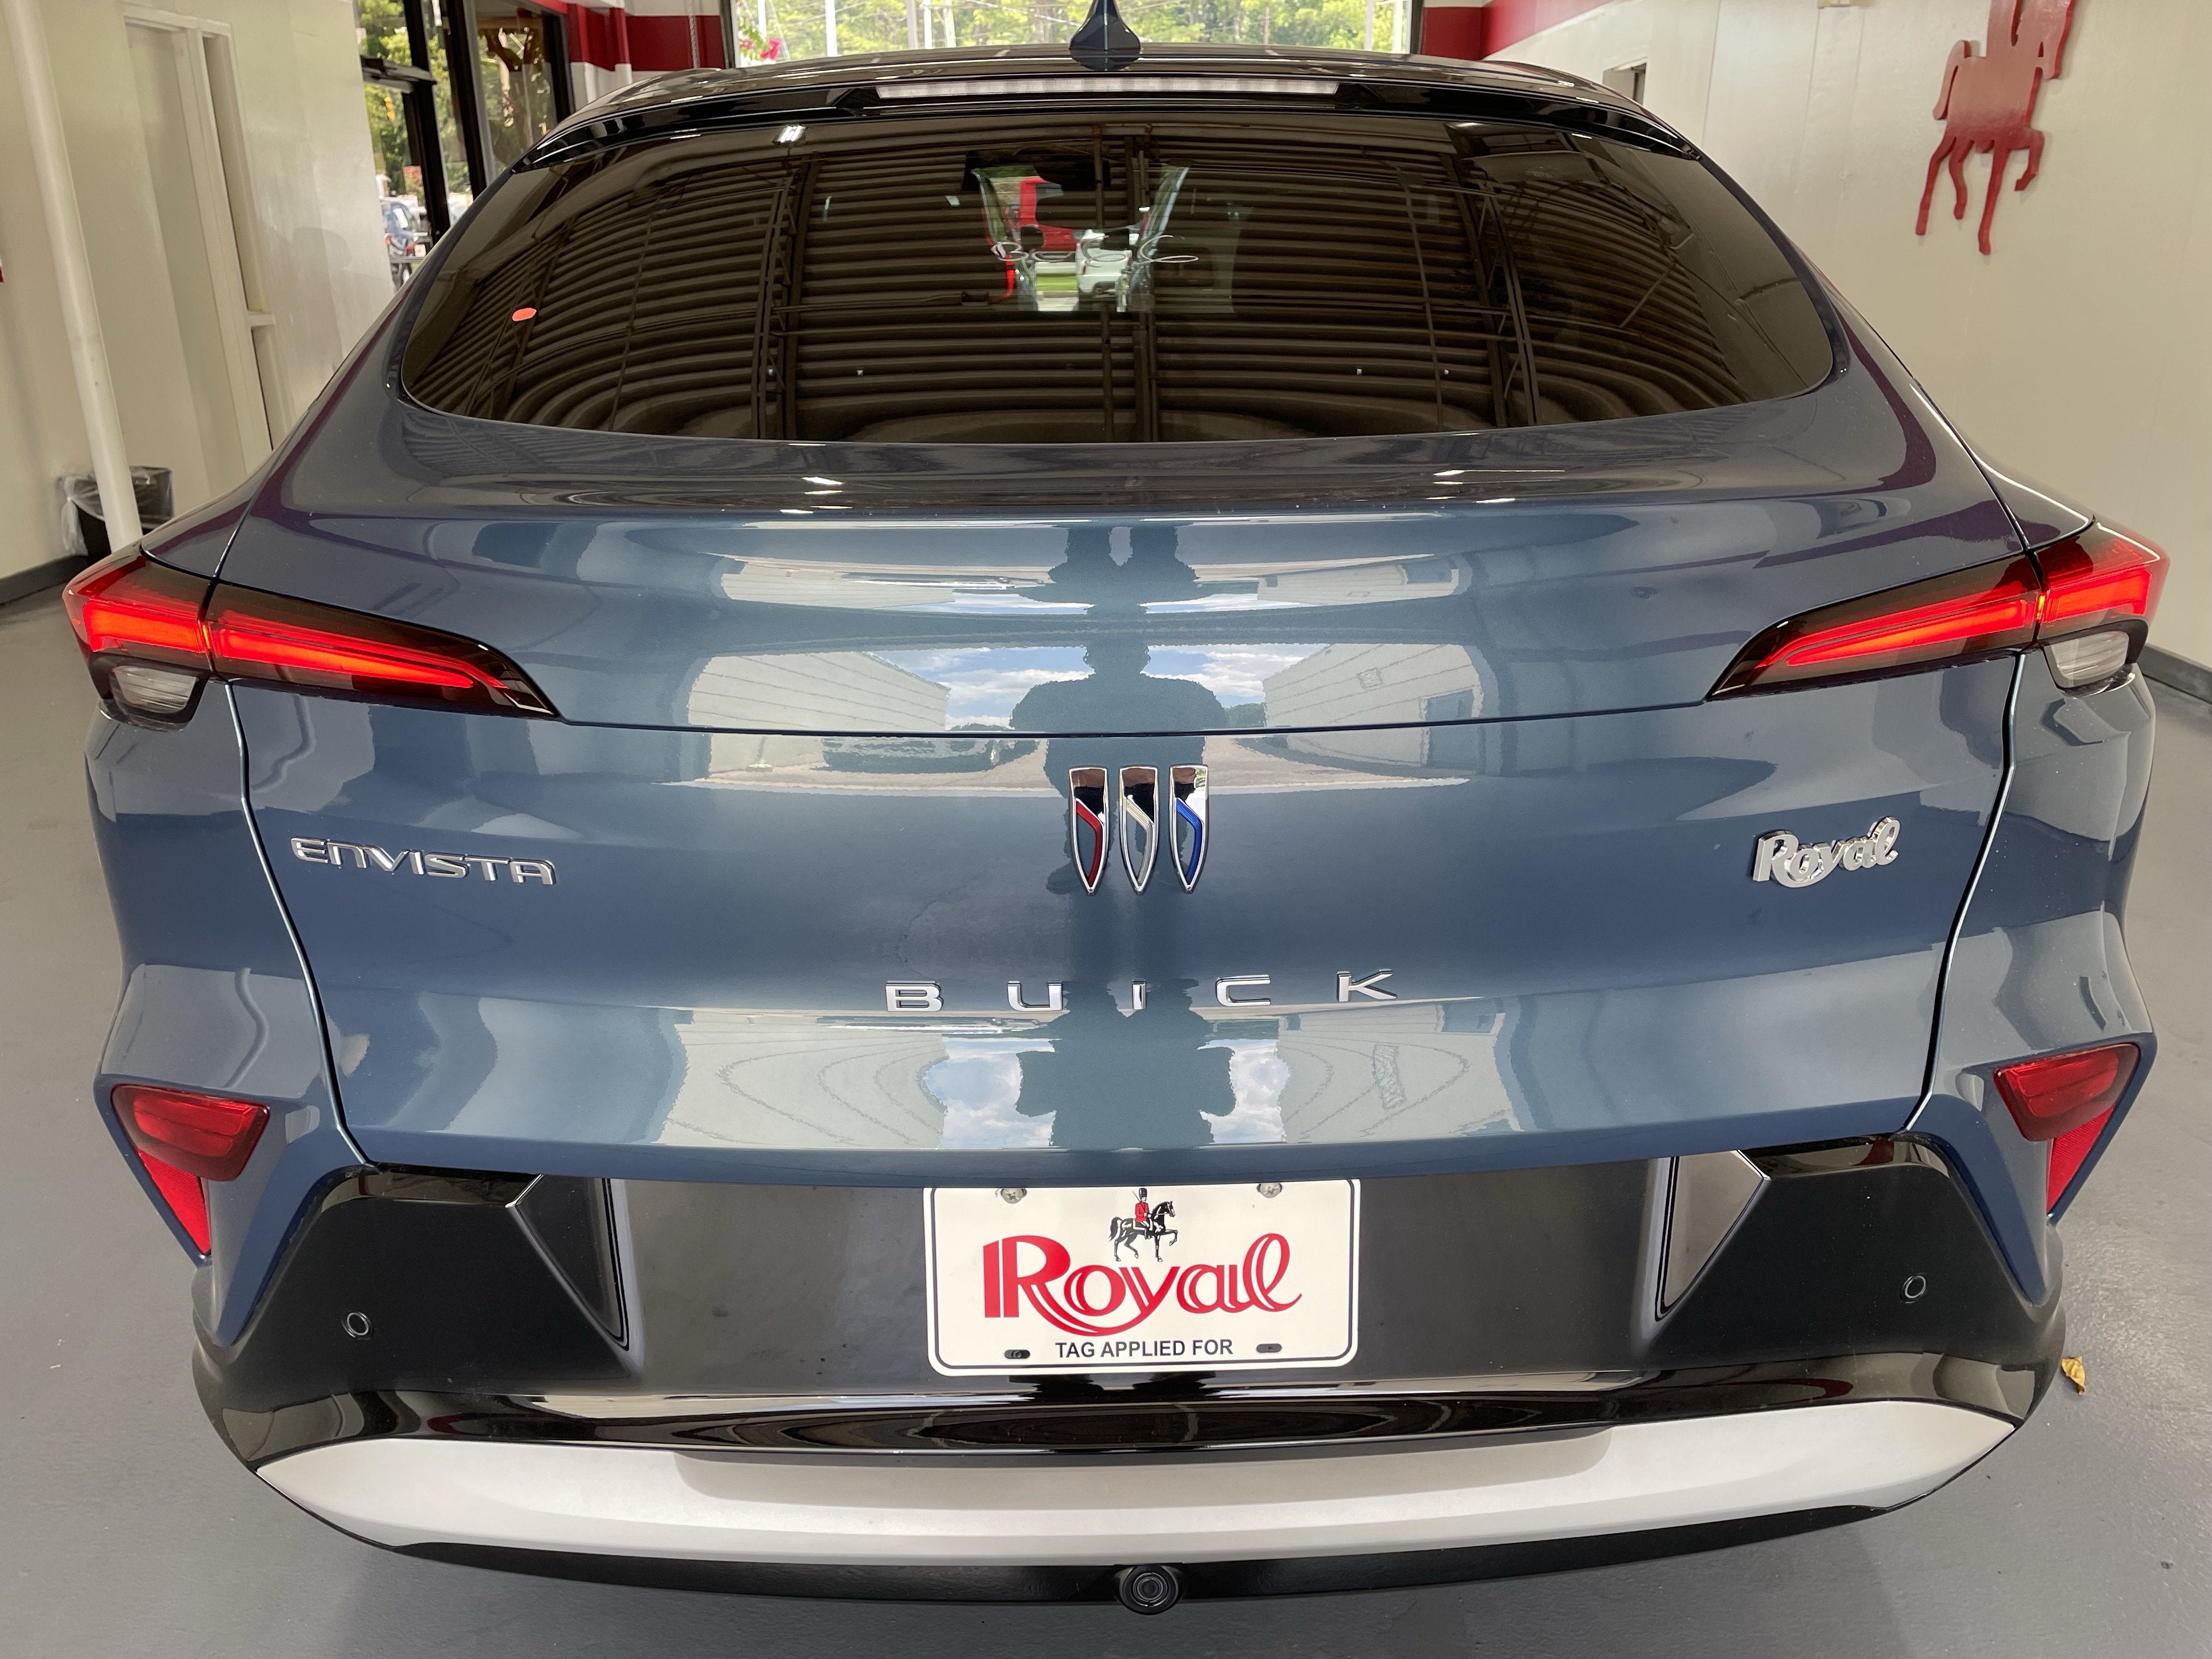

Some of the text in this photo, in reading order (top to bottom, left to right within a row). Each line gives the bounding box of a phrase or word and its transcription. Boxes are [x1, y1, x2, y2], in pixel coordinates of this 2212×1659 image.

[290, 837, 556, 885] ENVISTA
[1753, 816, 1900, 888] Royal
[885, 969, 1398, 1012] BUICK
[983, 1233, 1302, 1336] Royal
[1055, 1339, 1233, 1358] TAG APPLIED FOR
